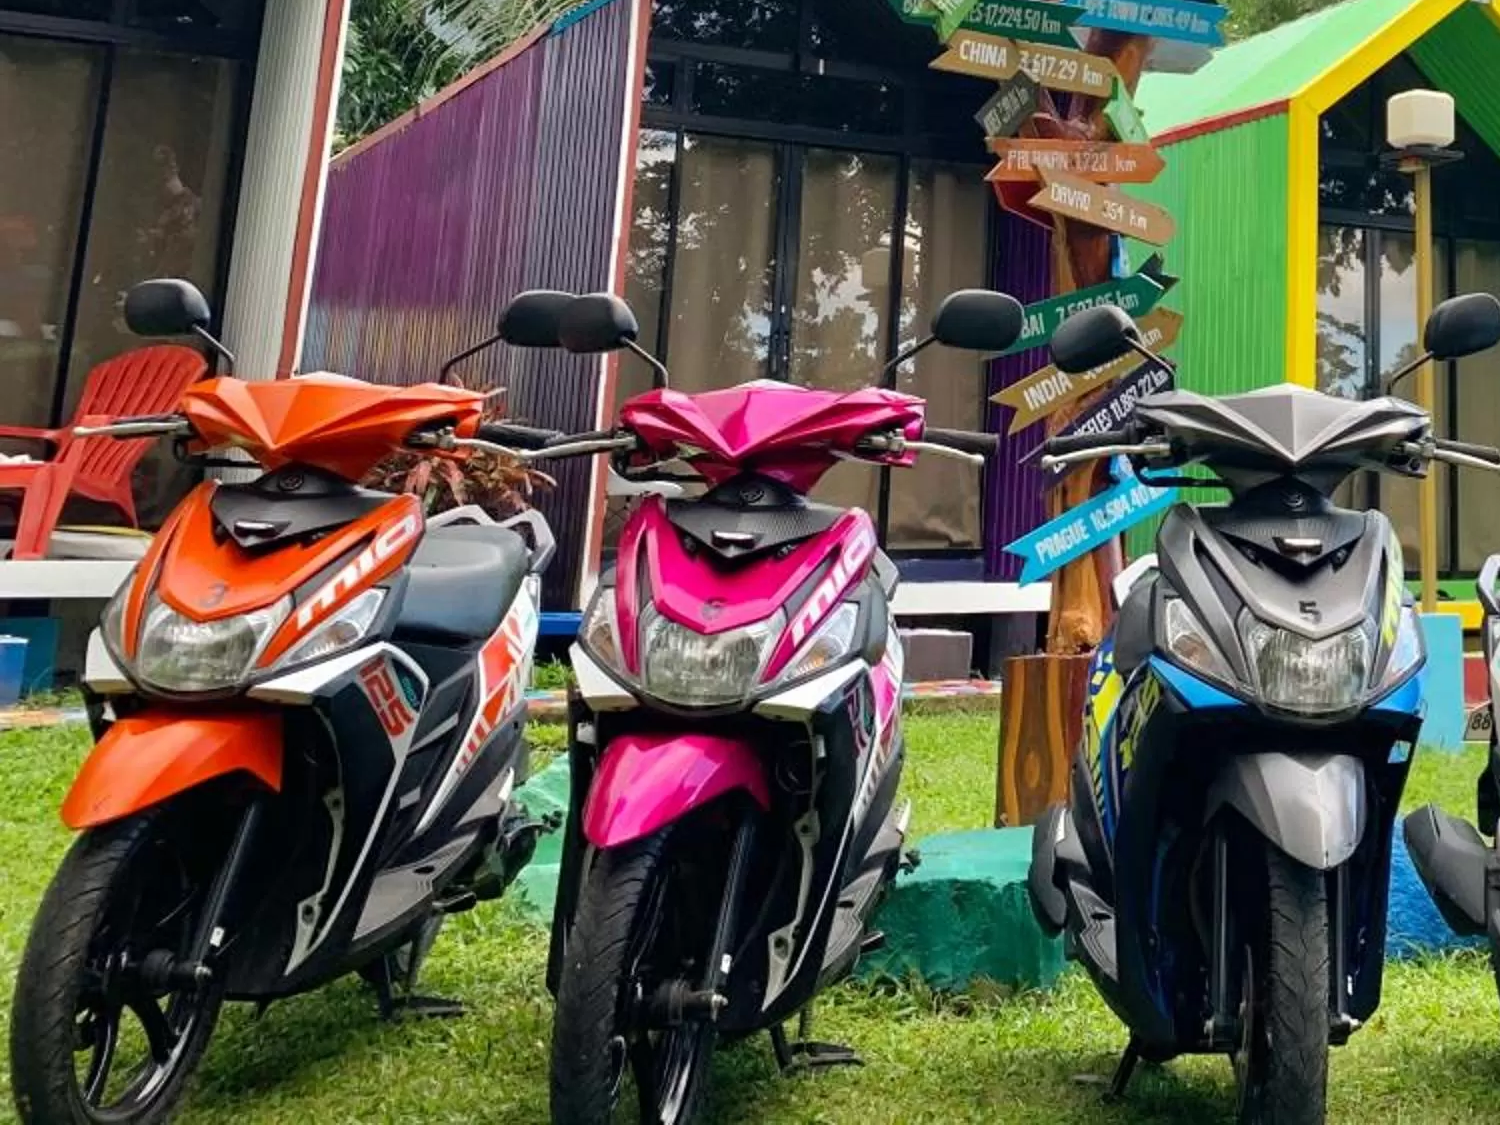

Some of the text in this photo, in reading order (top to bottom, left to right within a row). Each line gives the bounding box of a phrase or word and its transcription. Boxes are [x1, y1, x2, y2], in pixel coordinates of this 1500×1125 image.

[1041, 12, 1062, 35] km
[959, 39, 1008, 68] CHINA
[1082, 63, 1104, 86] km
[1115, 154, 1137, 172] km
[1051, 182, 1092, 212] DAVAO
[1129, 208, 1149, 231] km
[1117, 289, 1140, 313] km
[1023, 371, 1074, 412] INDIA
[1150, 368, 1169, 390] km
[1035, 517, 1091, 565] PRAGUE
[1298, 599, 1322, 626] 5
[358, 655, 415, 739] 125
